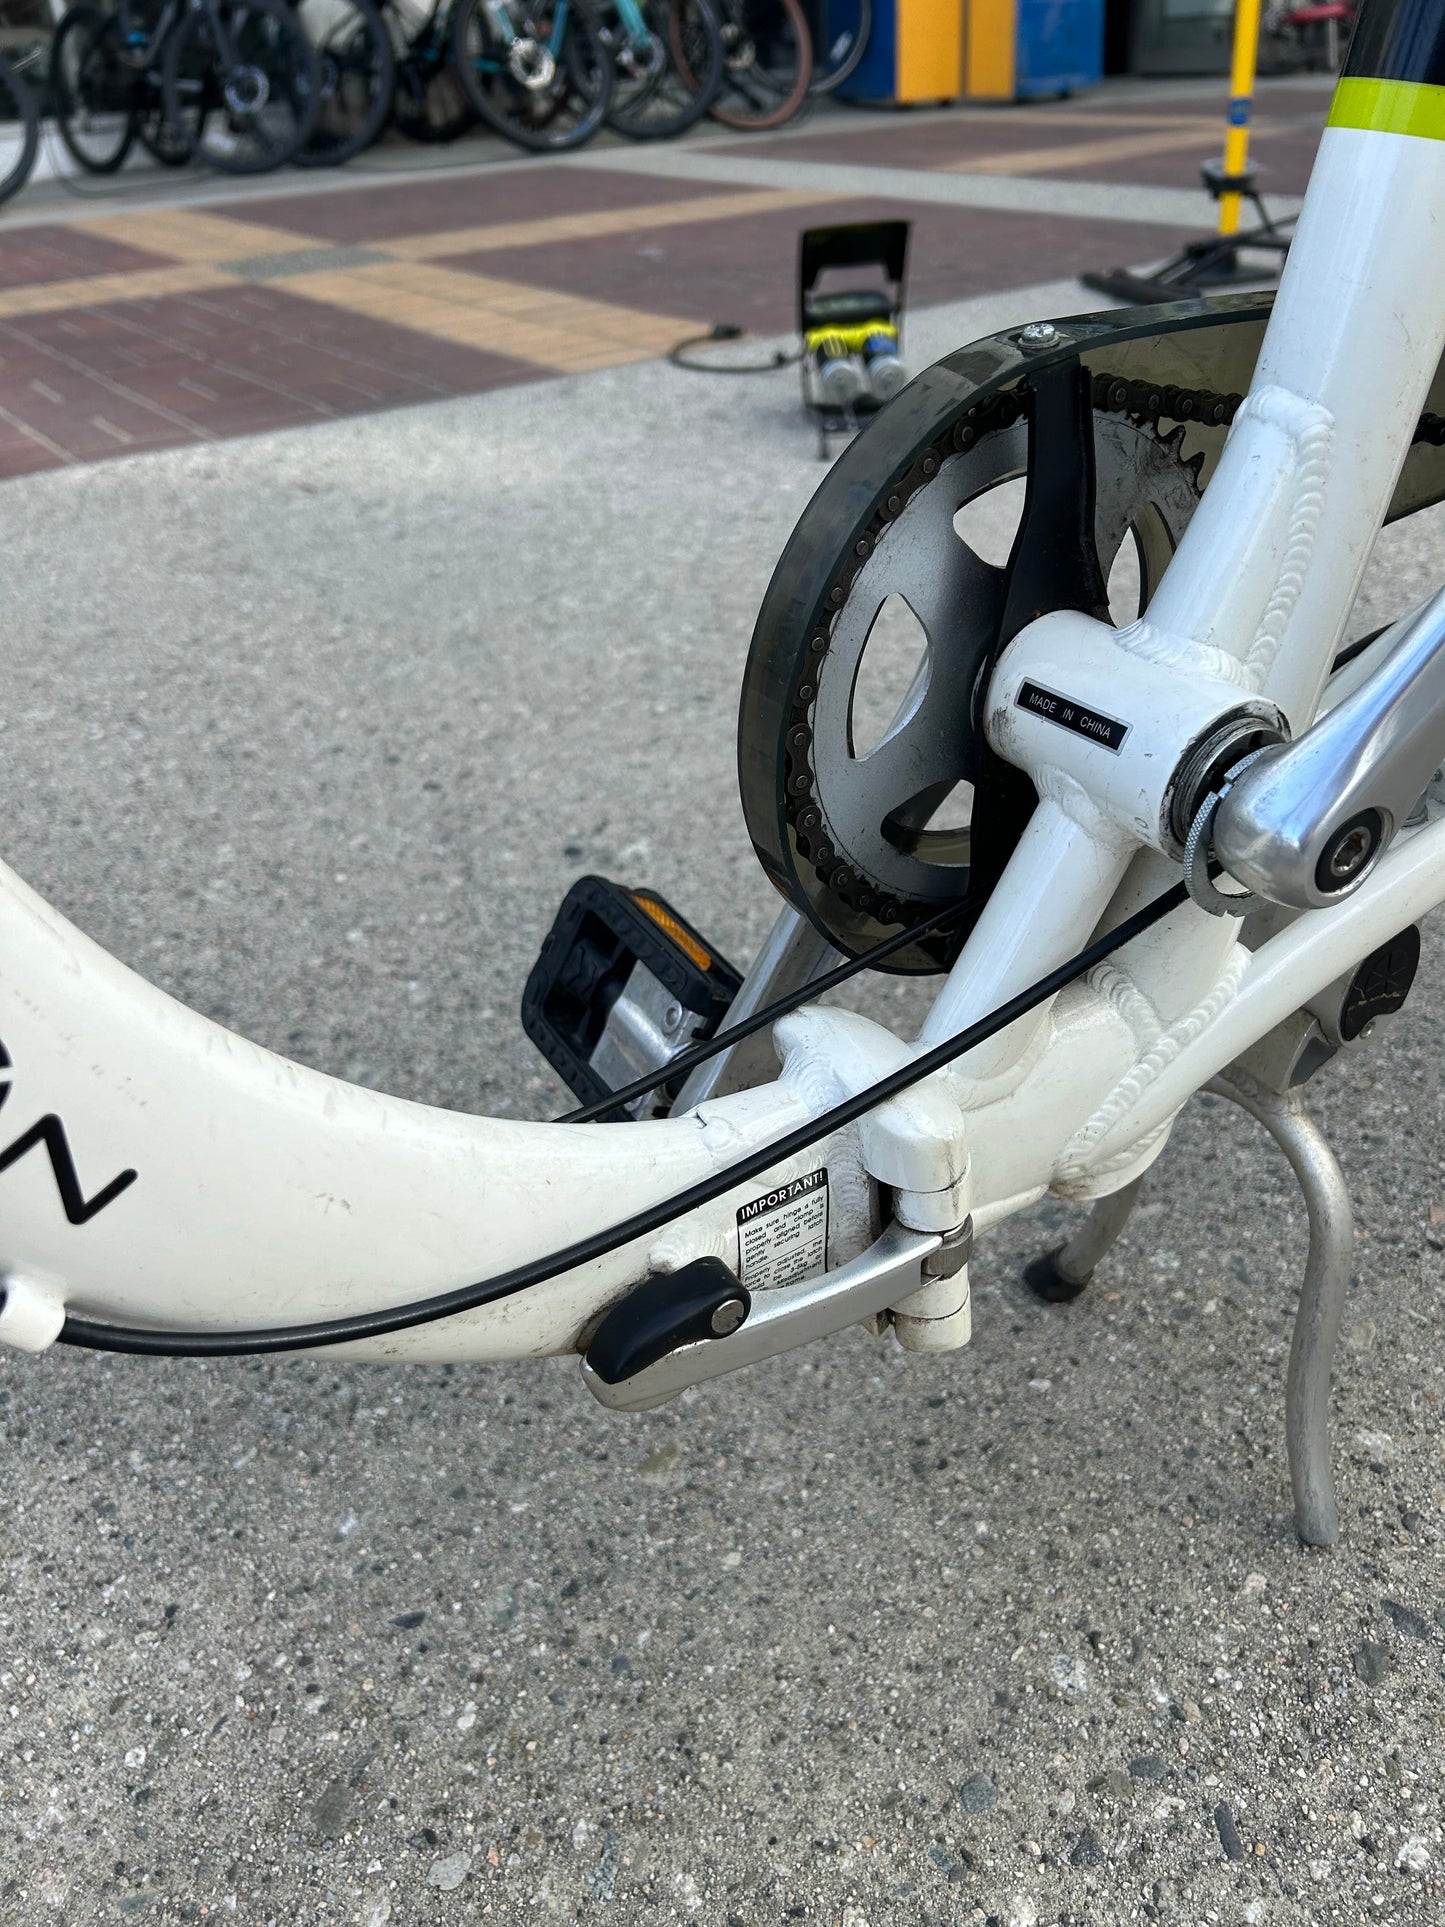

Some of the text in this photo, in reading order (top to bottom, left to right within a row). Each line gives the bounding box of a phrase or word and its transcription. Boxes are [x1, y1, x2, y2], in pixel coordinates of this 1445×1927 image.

[1029, 693, 1110, 739] MADE IN CHINA
[741, 1171, 823, 1219] IMPORTANT!
[744, 1226, 763, 1238] Make
[766, 1218, 779, 1228] sure
[784, 1208, 802, 1220] hinge
[812, 1196, 824, 1205] fully
[745, 1233, 767, 1246] closed
[774, 1222, 786, 1232] and
[794, 1209, 814, 1223] clamp
[745, 1212, 823, 1256] properly aligned before
[744, 1267, 770, 1282] Properly
[812, 1240, 822, 1248] the
[745, 1220, 823, 1263] gently securing latch
[774, 1264, 790, 1274] close
[794, 1258, 804, 1266] the
[807, 1247, 823, 1258] latch
[773, 1274, 782, 1282] be
